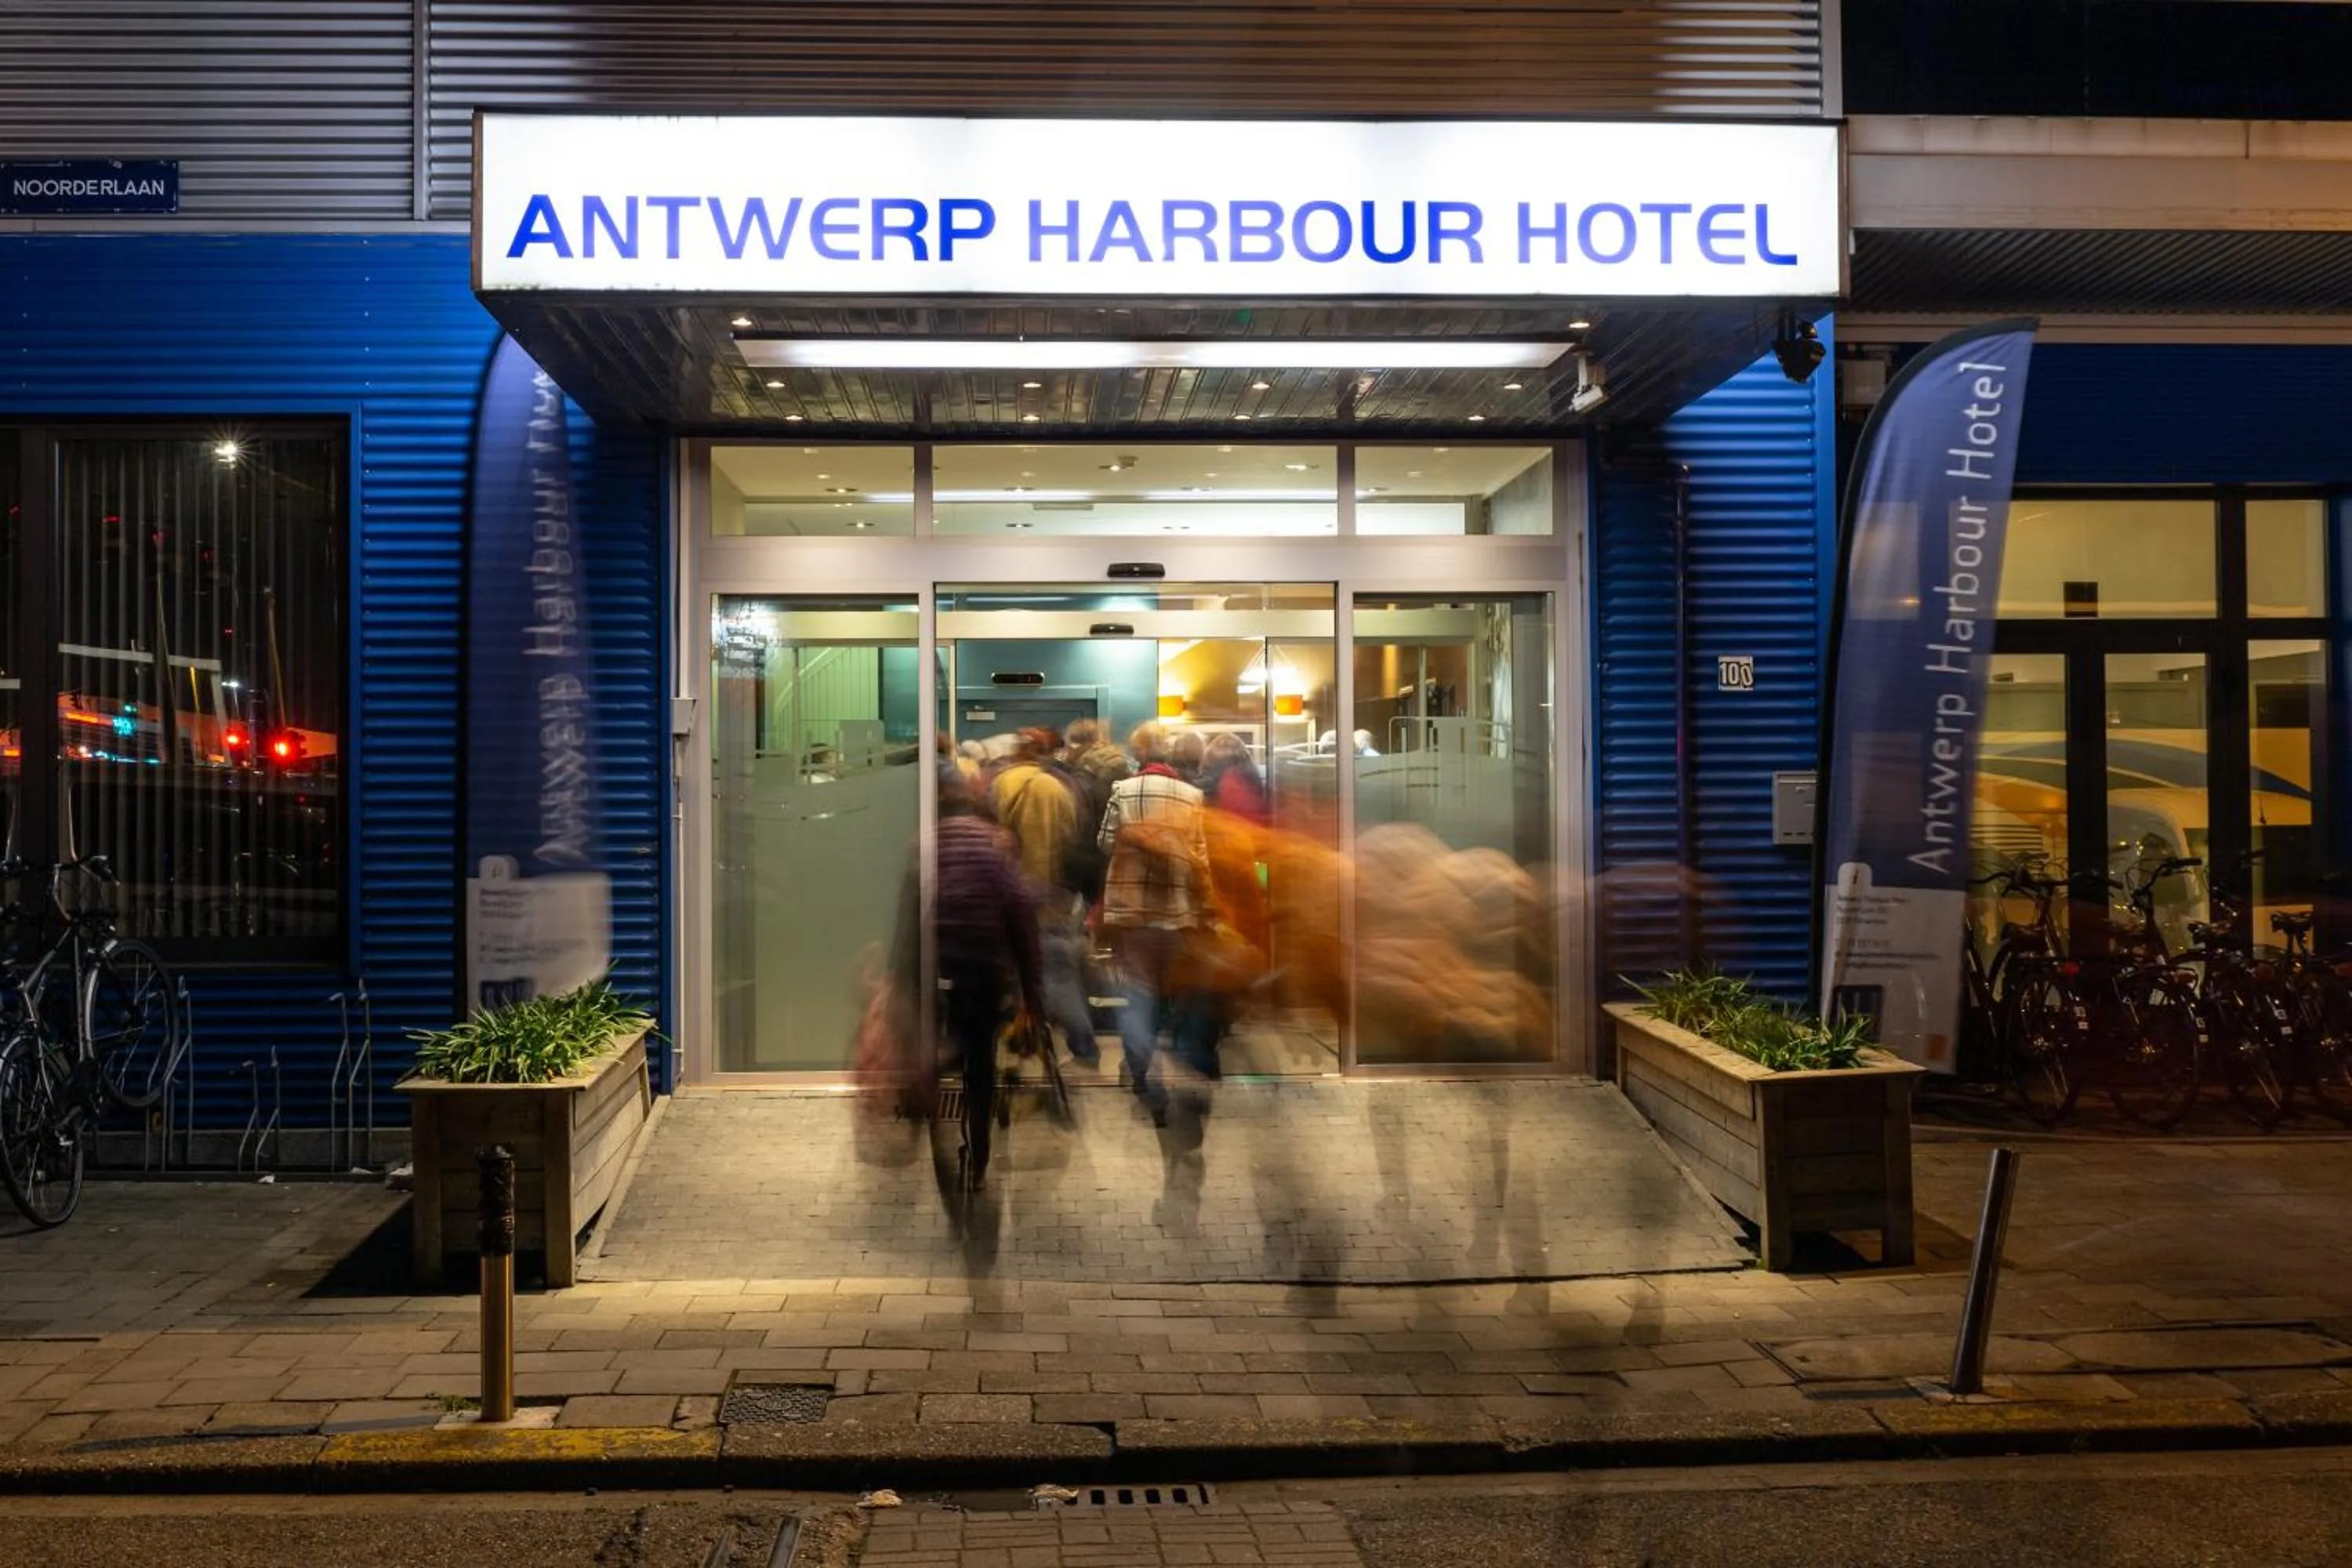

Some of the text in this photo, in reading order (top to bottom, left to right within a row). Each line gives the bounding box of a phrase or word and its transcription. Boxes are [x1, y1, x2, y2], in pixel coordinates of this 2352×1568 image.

[13, 180, 165, 196] NOORDERLAAN
[506, 194, 1798, 266] ANTWERP HARBOUR HOTEL
[1907, 362, 2006, 874] Antwerp Harbour Hotel
